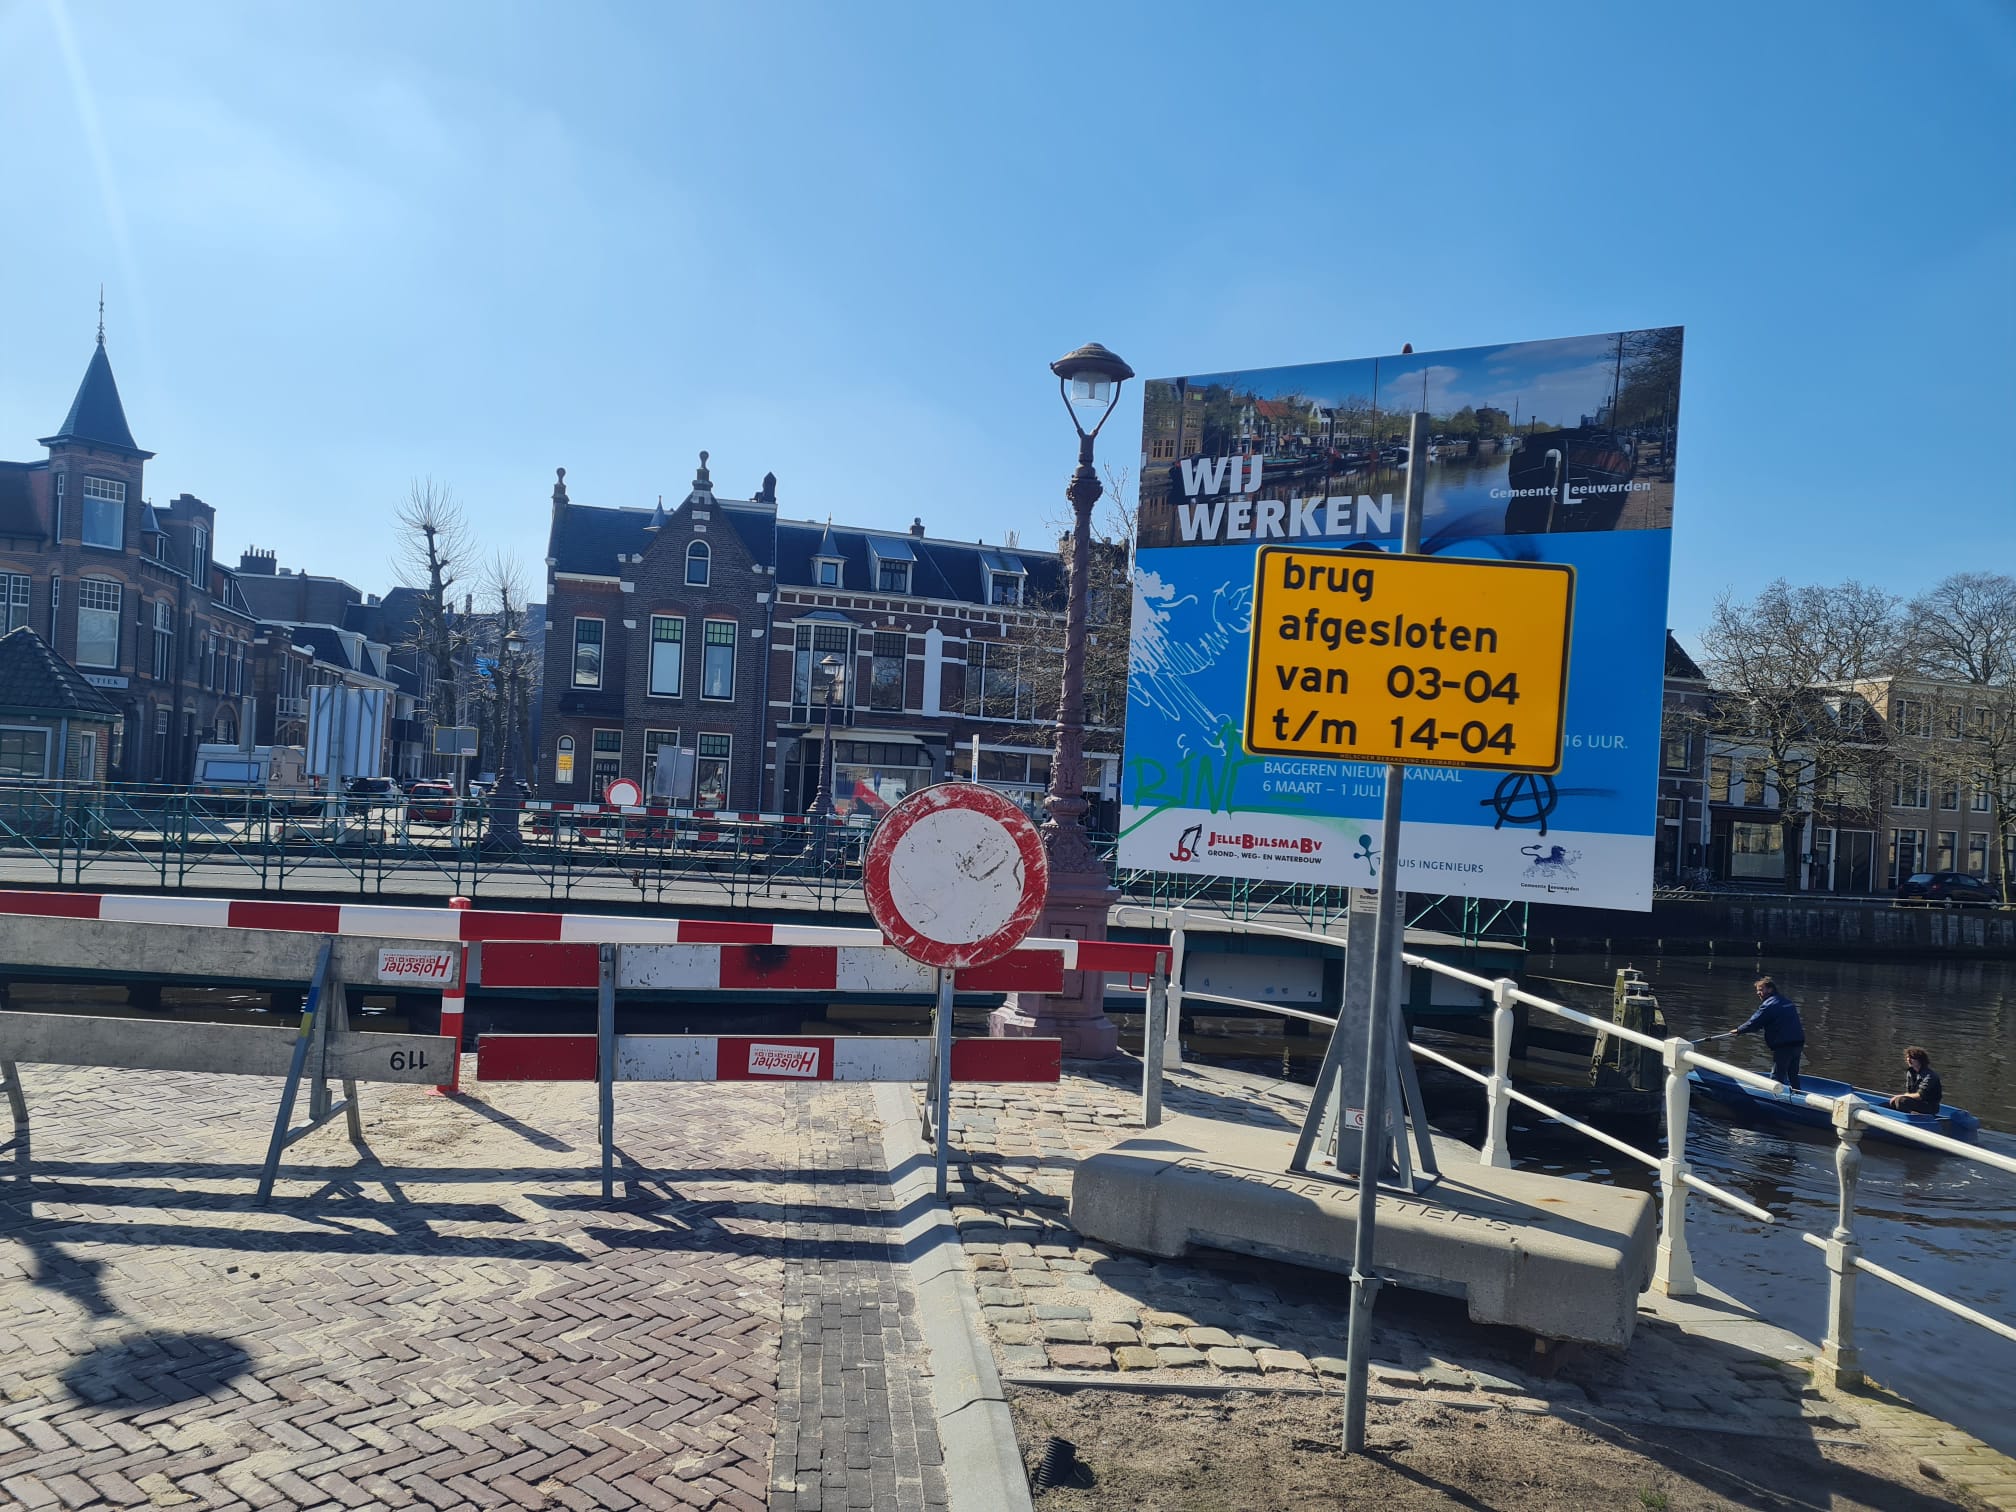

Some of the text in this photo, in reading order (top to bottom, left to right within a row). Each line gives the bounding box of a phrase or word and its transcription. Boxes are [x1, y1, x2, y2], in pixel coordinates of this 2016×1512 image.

[1180, 454, 1264, 496] WIJ
[1488, 479, 1652, 505] Gemeente Leeuwarden
[1178, 493, 1394, 541] WERKEN
[1283, 556, 1375, 602] brug
[1278, 608, 1498, 654] afgesloten
[1276, 663, 1522, 706] van 03-04
[1272, 707, 1518, 756] t/m 14-04
[1588, 735, 1629, 749] UUR.
[1263, 761, 1463, 782] BAGGEREN NIEUW KANAAL
[1263, 780, 1271, 792] 6
[1275, 780, 1322, 794] MAART
[1341, 783, 1347, 796] 1
[1352, 784, 1381, 798] JULI
[1207, 849, 1323, 865] GROND-, WEG- EN WATERBOUW
[1418, 860, 1485, 873] INGENIEURS
[382, 955, 451, 978] Holscher
[390, 1050, 429, 1071] 119
[752, 1051, 816, 1073] Holscher
